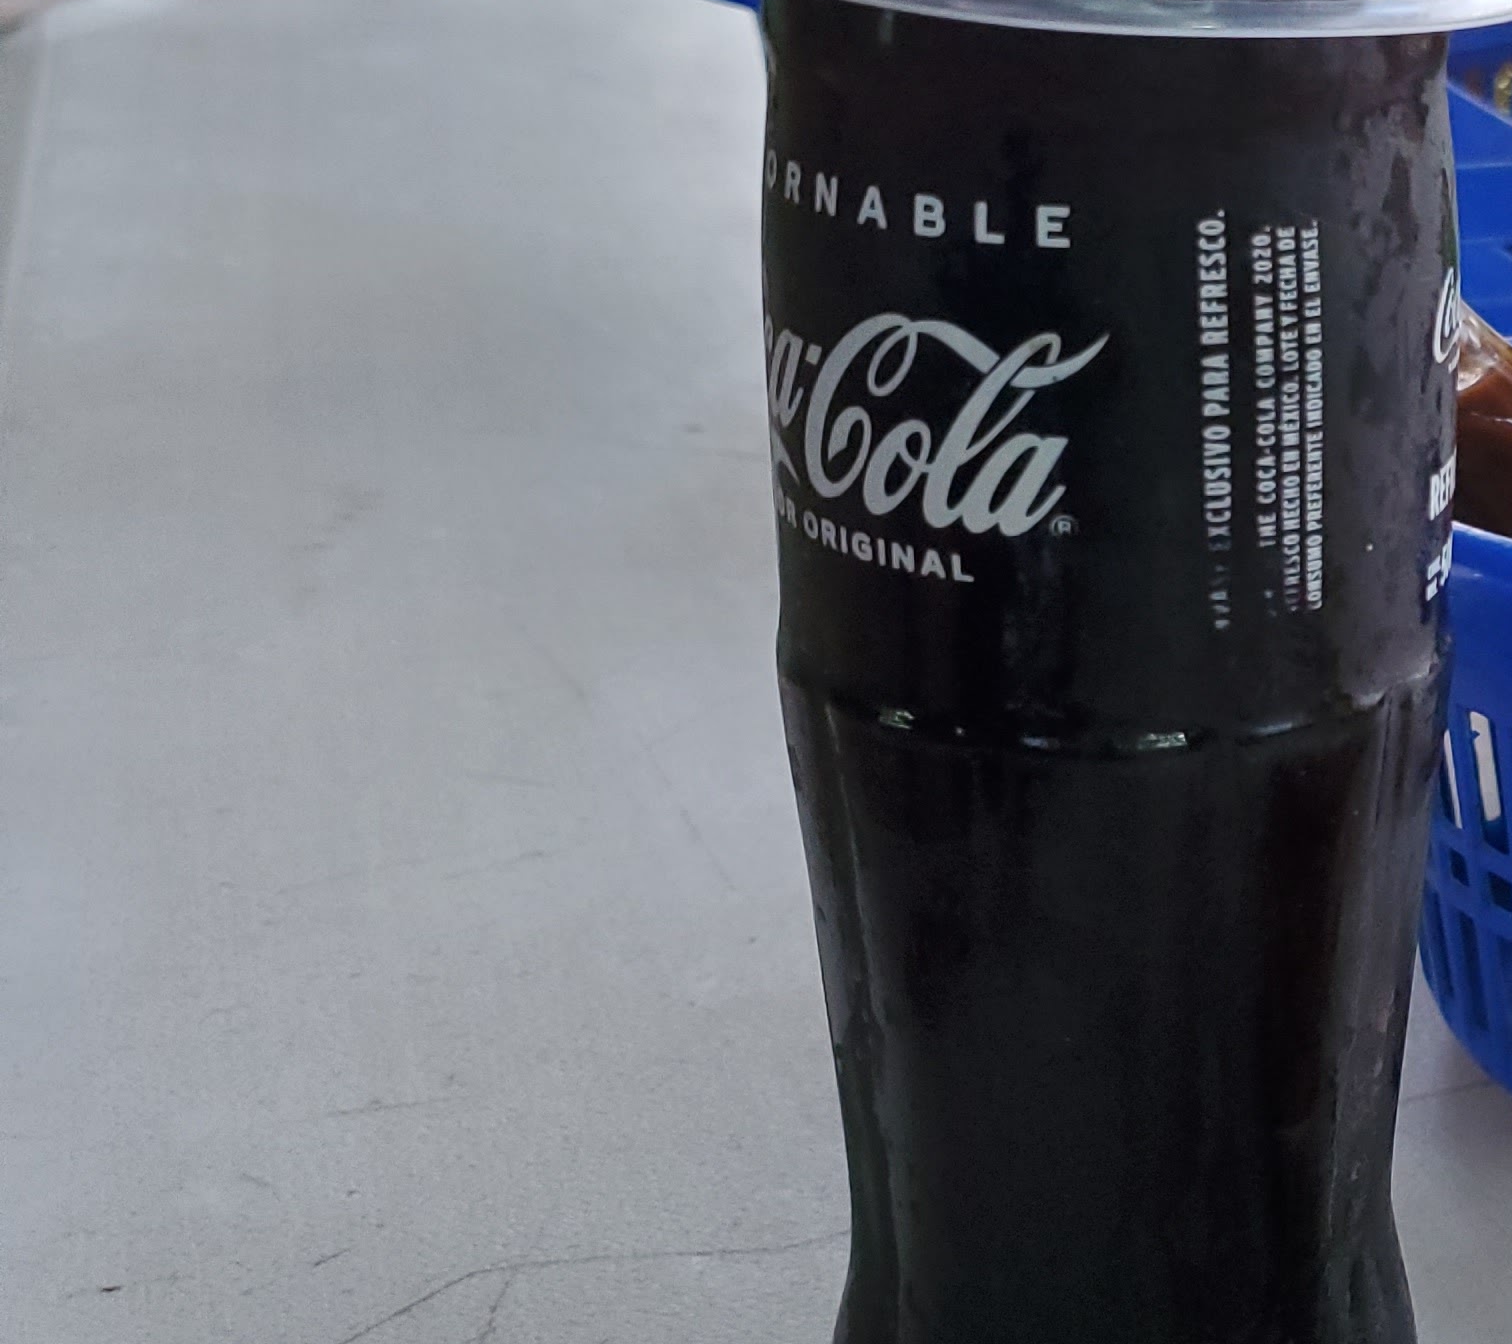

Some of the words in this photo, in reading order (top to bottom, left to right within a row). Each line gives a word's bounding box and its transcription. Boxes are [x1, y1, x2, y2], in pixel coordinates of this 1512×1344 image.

[1251, 225, 1274, 285] 2020.
[1275, 226, 1296, 252] DE
[1301, 219, 1321, 294] ENVASE.
[1197, 209, 1229, 346] REFRESCO.
[1278, 254, 1298, 311] FECHA
[1303, 296, 1322, 318] EL
[1254, 295, 1276, 389] COMPANY
[1279, 314, 1299, 328] Y
[1279, 328, 1300, 372] LOTE
[1303, 322, 1323, 345] EN
[1202, 353, 1231, 417] PARA
[1304, 348, 1324, 429] INDICADO
[1255, 397, 1277, 505] COCA-COLA
[1305, 430, 1324, 532] PREFERENTE
[1281, 475, 1301, 531] HECHO
[803, 510, 975, 583] ORIGINAL
[1306, 534, 1323, 610] CONSUMO
